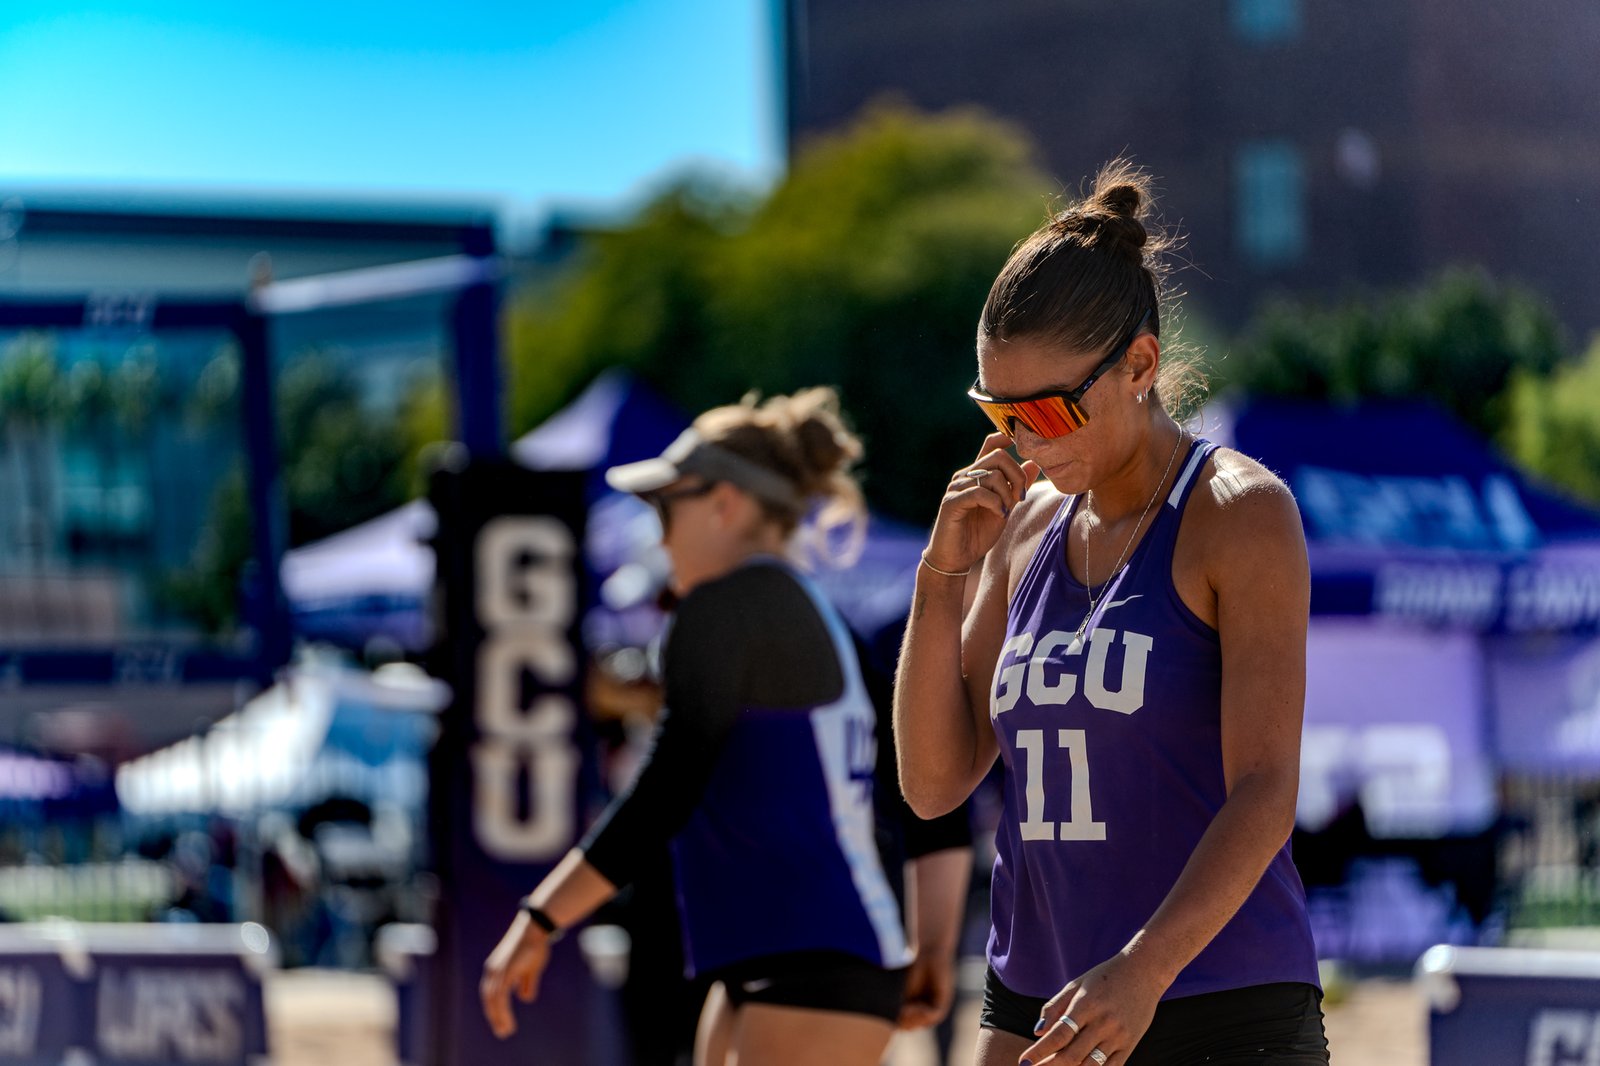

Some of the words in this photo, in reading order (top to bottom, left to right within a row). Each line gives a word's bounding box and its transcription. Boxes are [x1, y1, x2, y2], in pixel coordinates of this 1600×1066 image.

[474, 515, 577, 862] GCU
[989, 628, 1153, 718] GCU
[1016, 729, 1106, 840] 11
